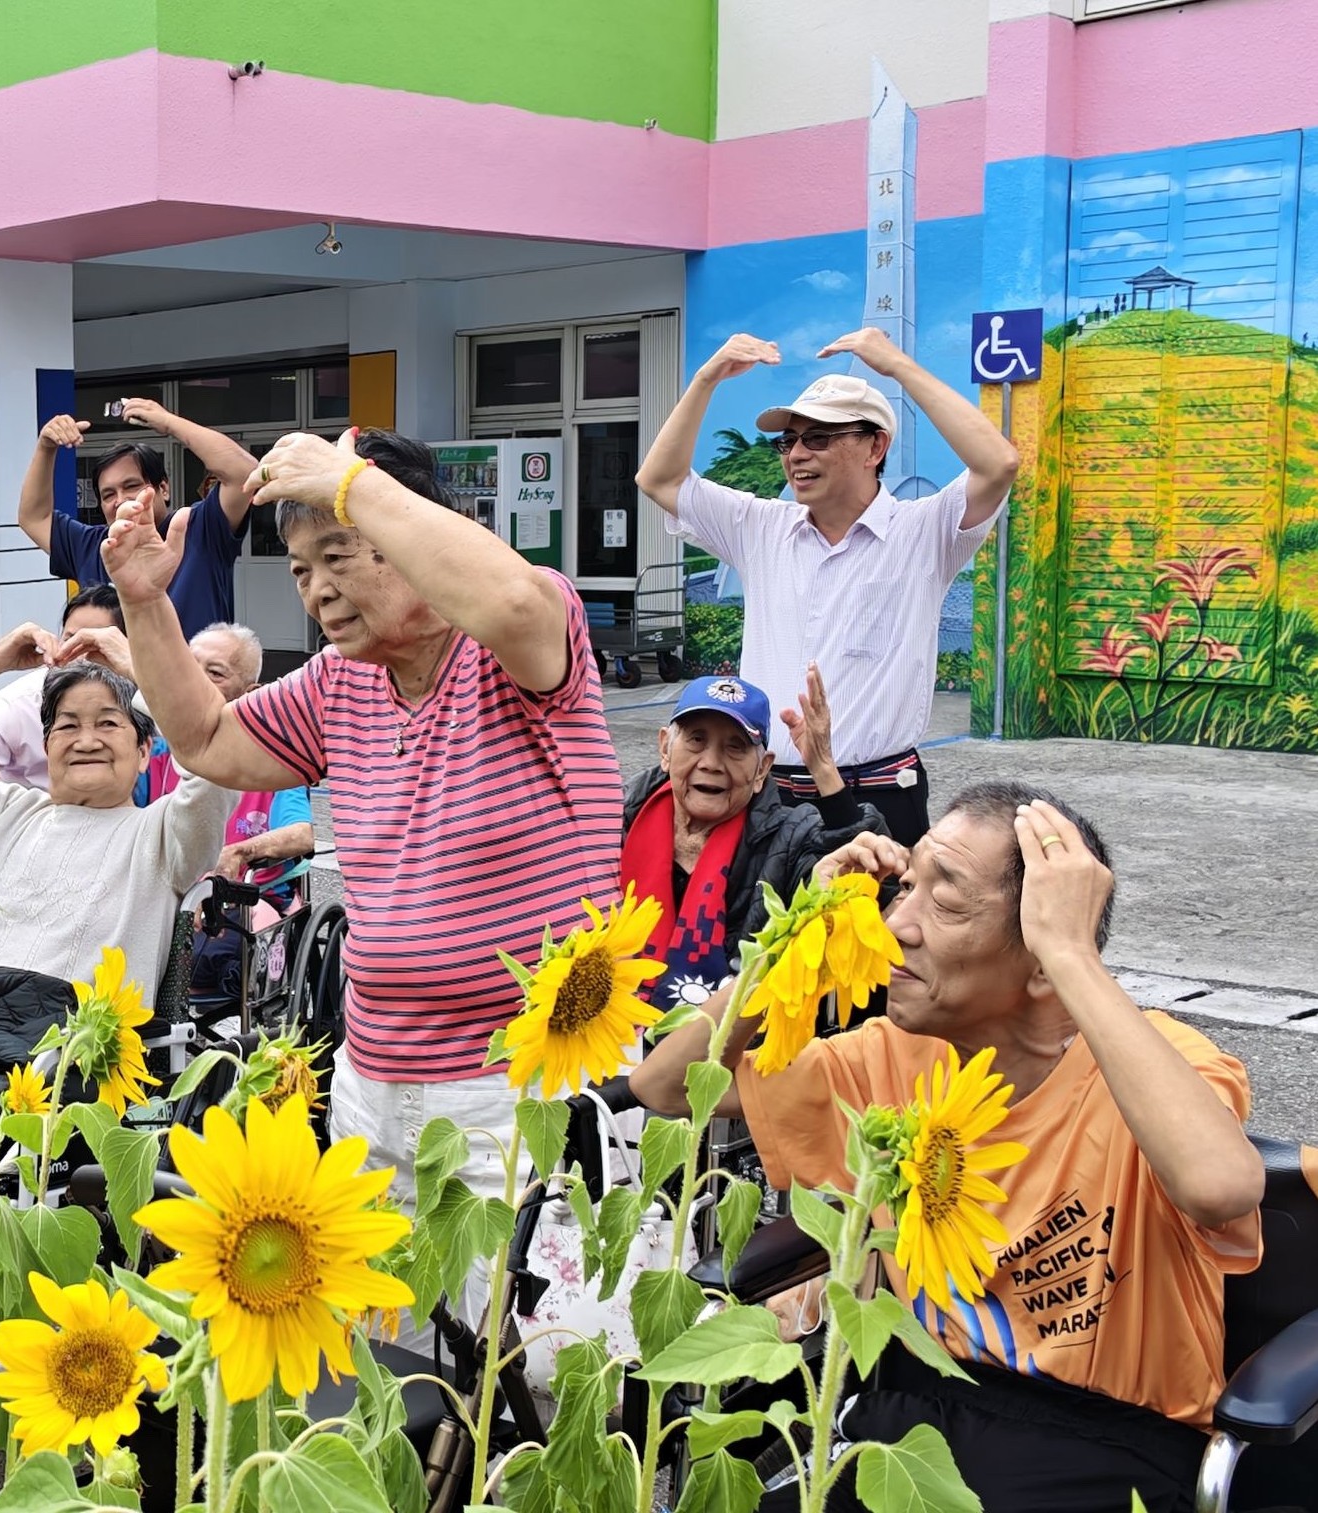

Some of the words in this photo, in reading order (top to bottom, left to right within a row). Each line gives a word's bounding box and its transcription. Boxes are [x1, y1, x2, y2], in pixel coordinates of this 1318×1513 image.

[876, 177, 894, 339] 北回歸線
[996, 1199, 1088, 1268] HUALIEN
[1010, 1236, 1095, 1287] PACIFIC
[1022, 1276, 1088, 1313] WAVE
